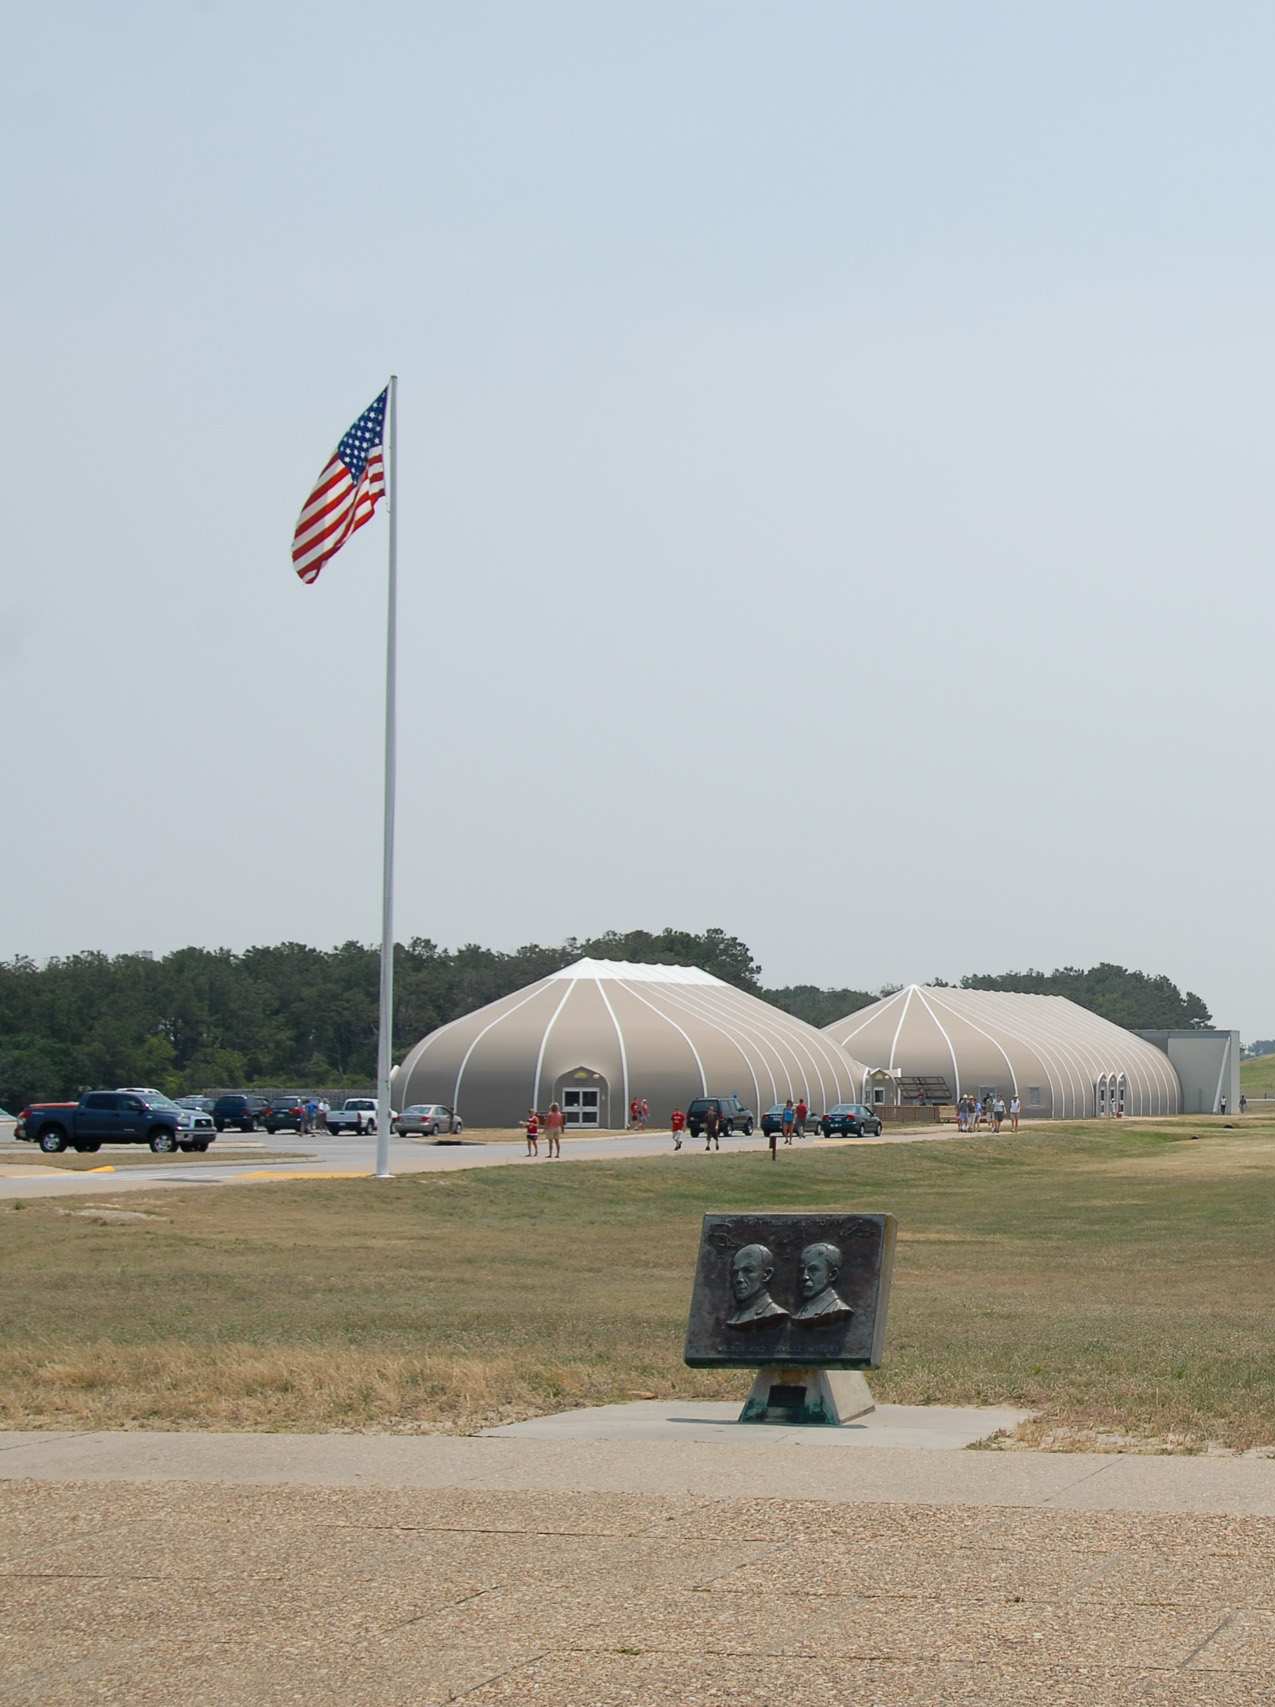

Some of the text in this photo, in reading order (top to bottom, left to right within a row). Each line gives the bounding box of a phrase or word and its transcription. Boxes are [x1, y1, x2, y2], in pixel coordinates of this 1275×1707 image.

[815, 1219, 826, 1227] TO
[750, 1345, 767, 1353] AND
[769, 1345, 802, 1353] ORVILLE
